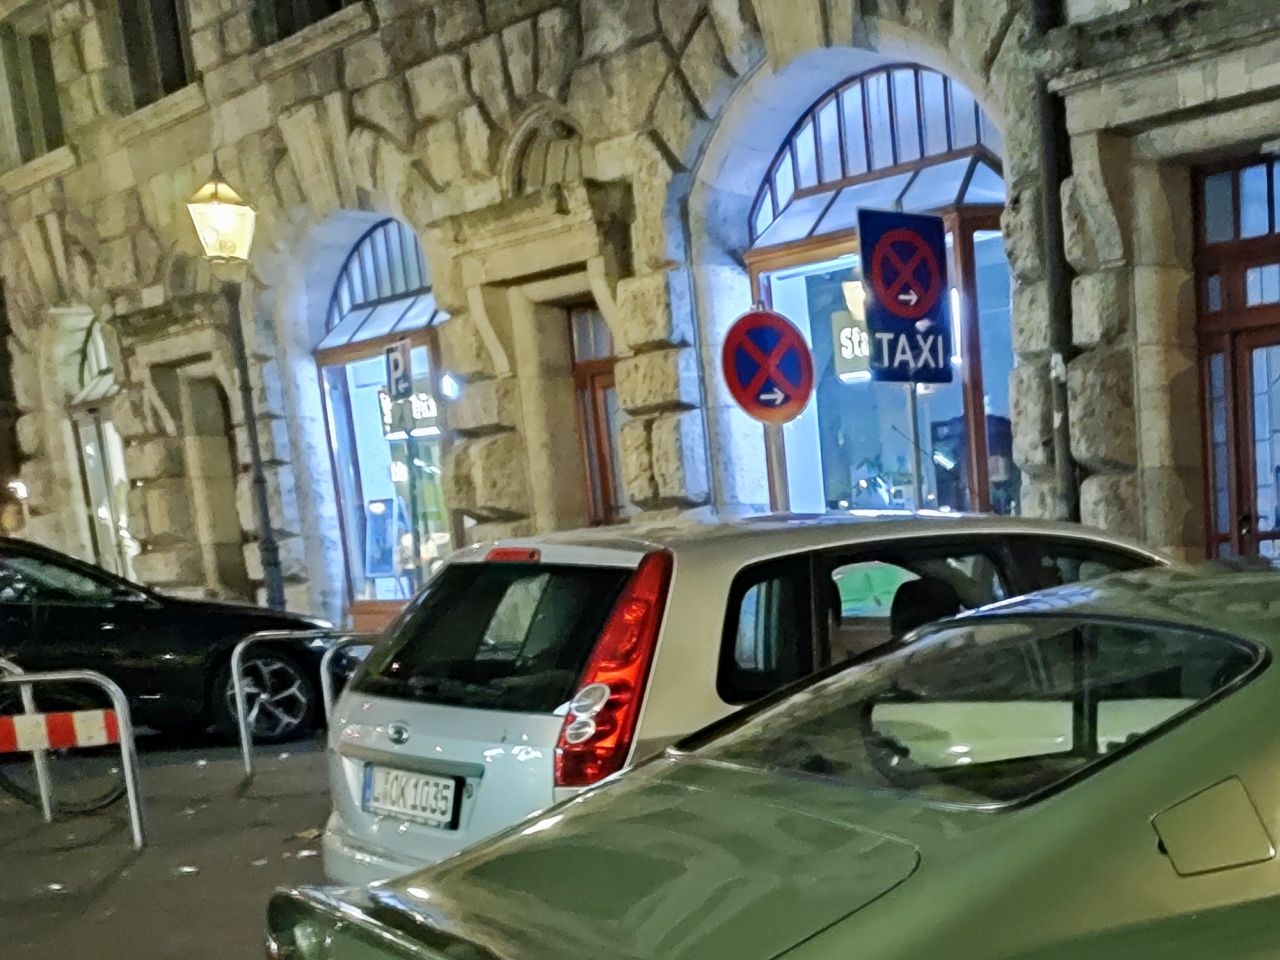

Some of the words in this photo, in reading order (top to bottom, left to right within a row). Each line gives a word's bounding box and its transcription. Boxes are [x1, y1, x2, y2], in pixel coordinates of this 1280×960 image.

[875, 332, 943, 368] TAXI
[389, 351, 404, 396] P
[411, 780, 450, 816] 1035
